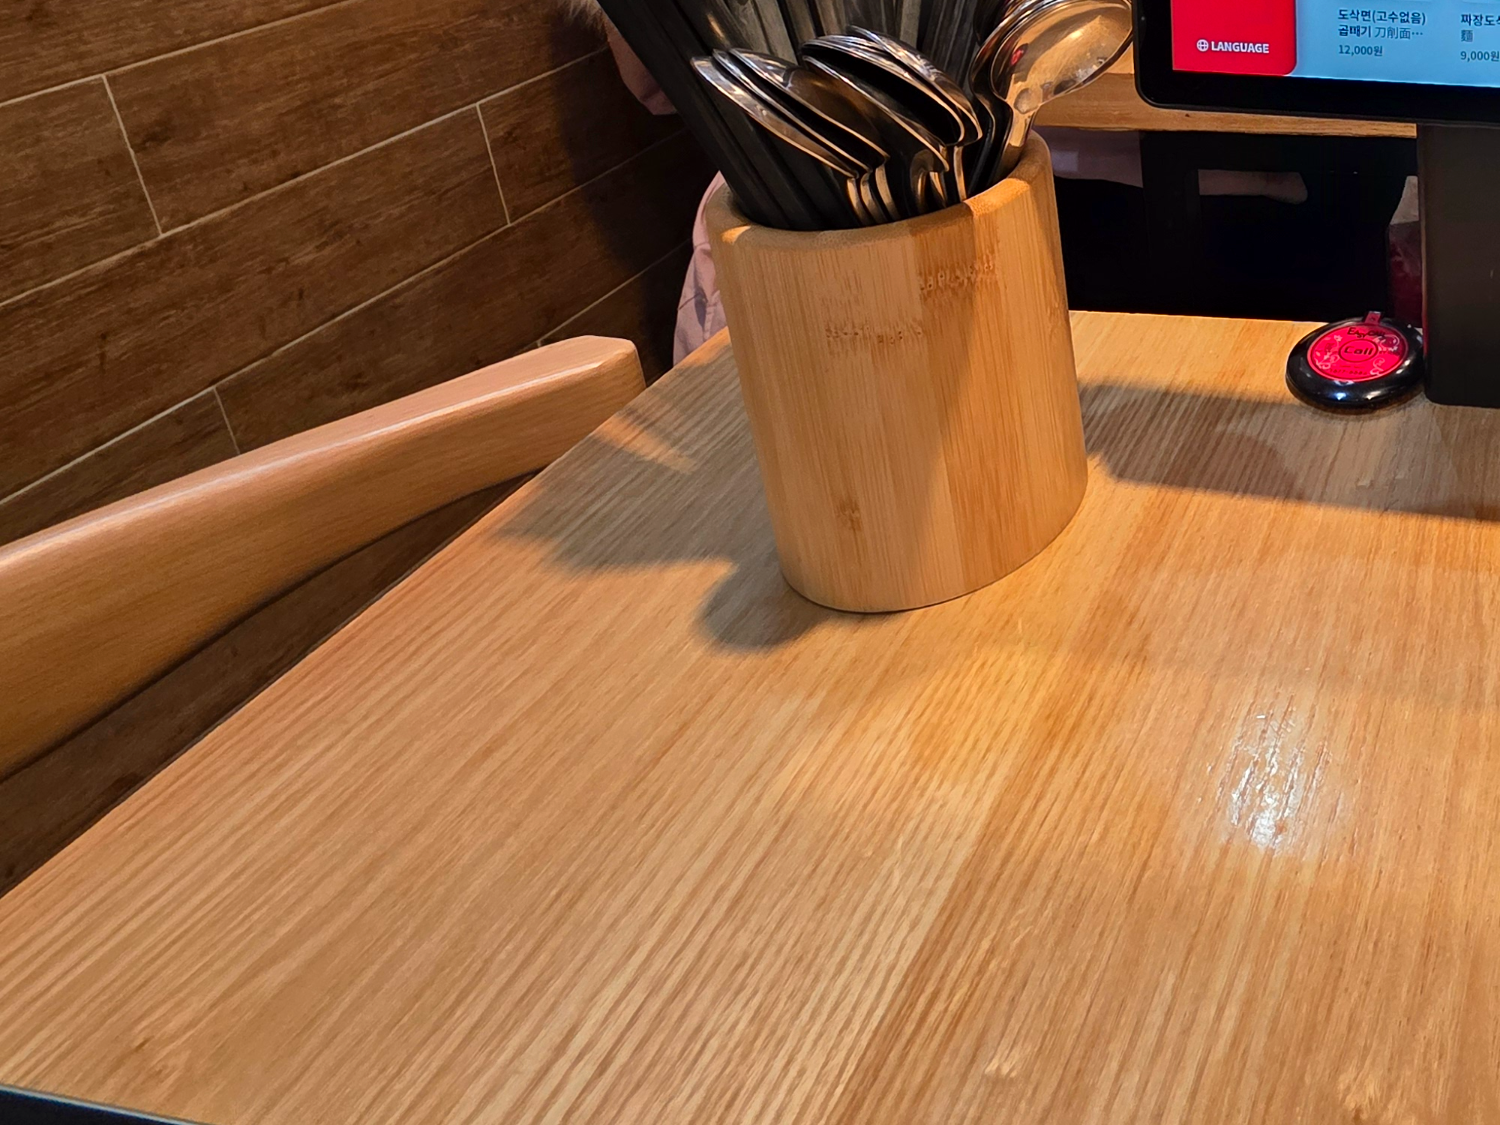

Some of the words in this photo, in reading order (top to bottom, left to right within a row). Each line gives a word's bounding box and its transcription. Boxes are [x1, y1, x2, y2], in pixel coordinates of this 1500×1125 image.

[1338, 9, 1426, 26] 도삭면(고수없음)
[1211, 41, 1270, 54] LANGUAGE
[1338, 44, 1384, 57] 12,000원
[1460, 51, 1500, 63] 9,000원
